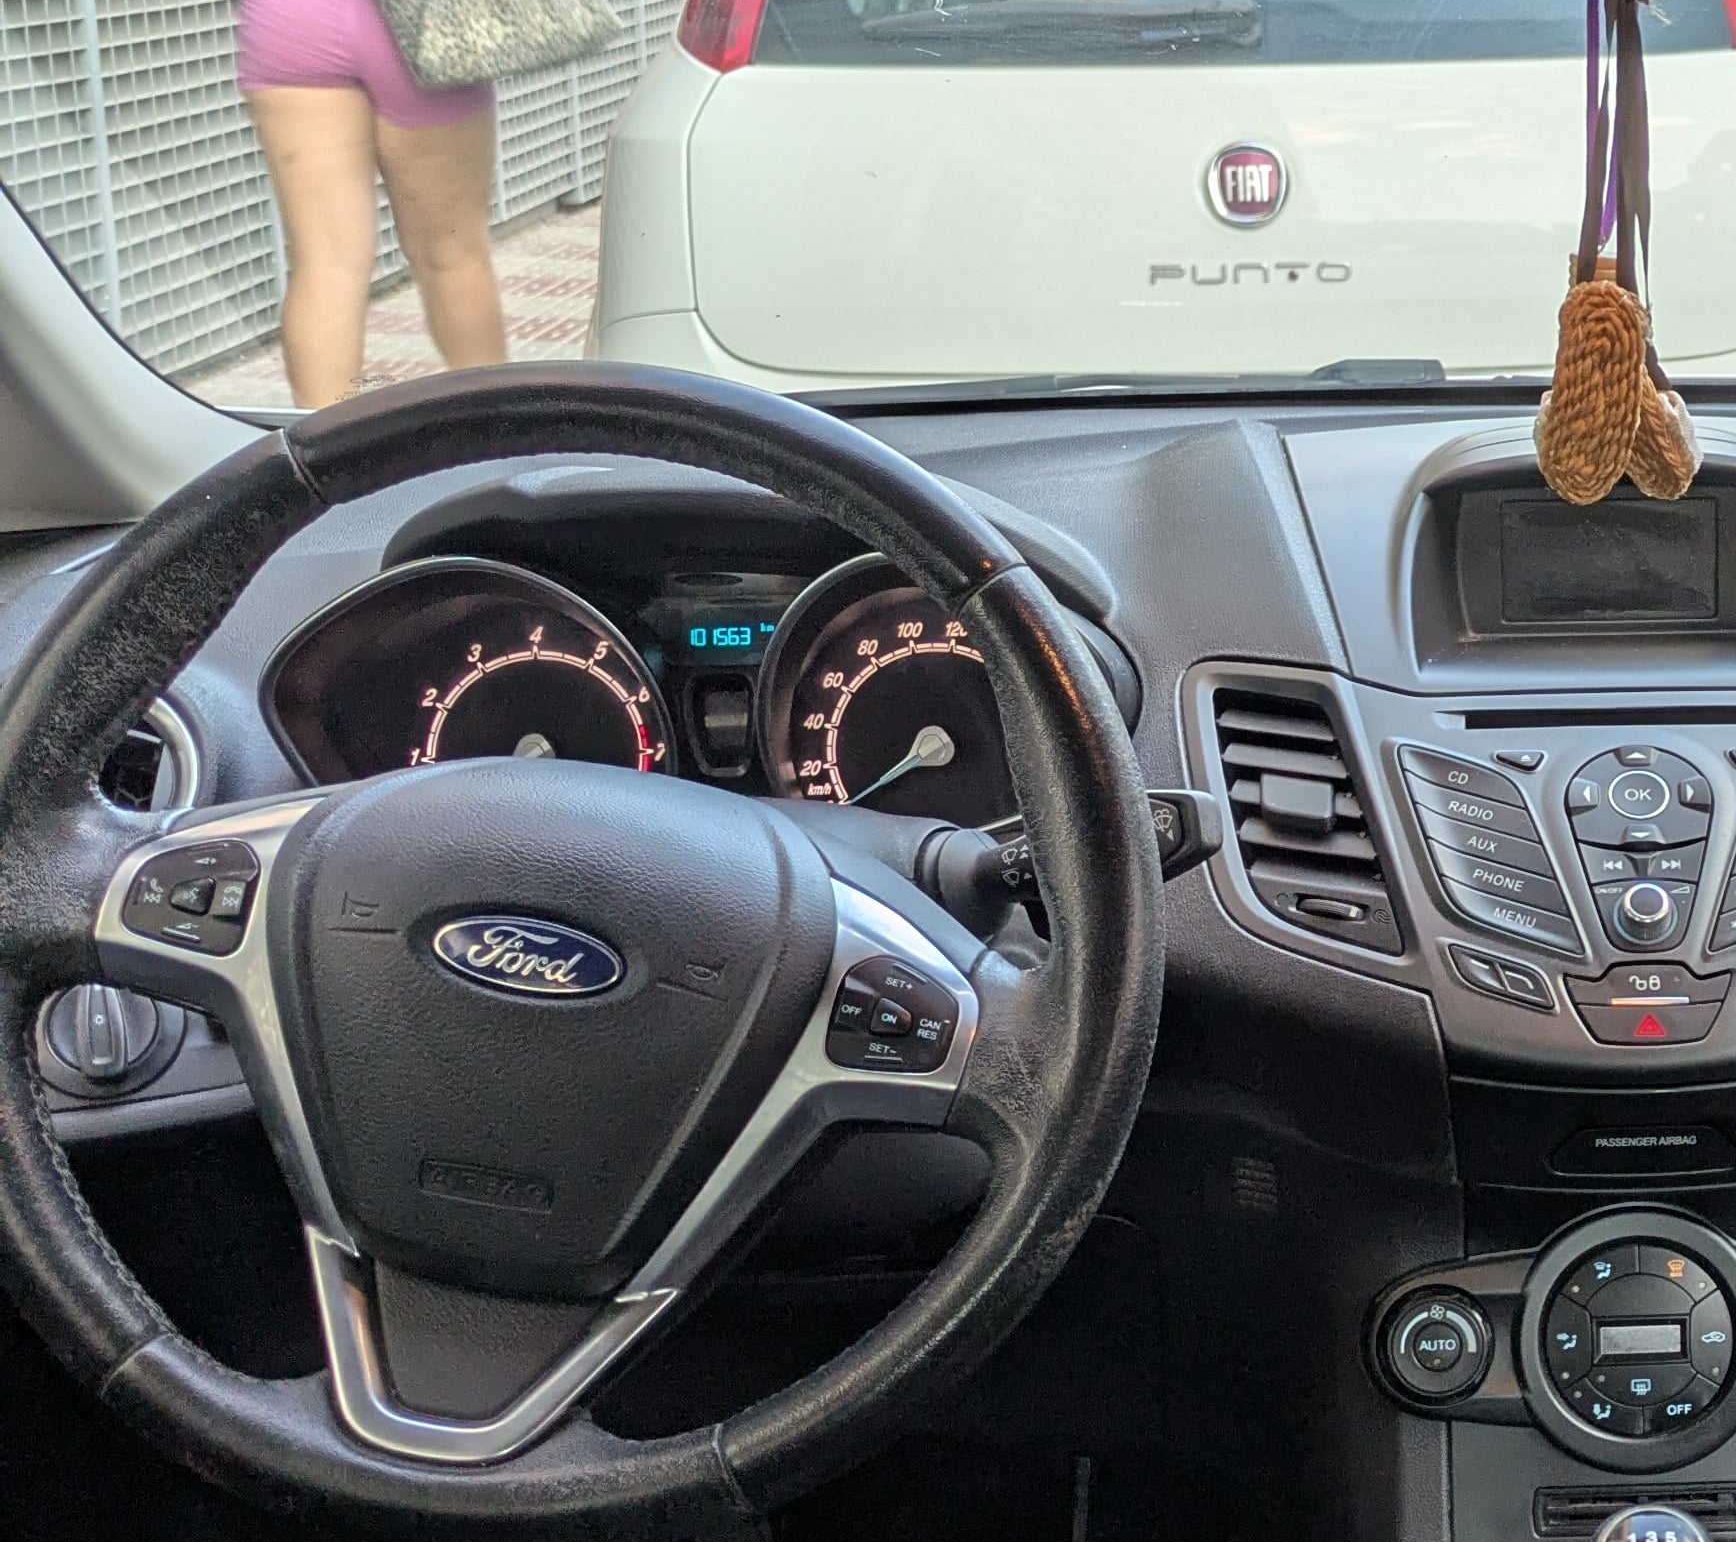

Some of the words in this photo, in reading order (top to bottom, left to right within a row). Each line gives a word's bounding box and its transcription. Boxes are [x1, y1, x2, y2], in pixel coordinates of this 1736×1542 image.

[1224, 163, 1273, 203] FIAT
[1150, 261, 1353, 286] PUNTO
[529, 626, 544, 644] 4
[897, 622, 923, 638] 100
[467, 643, 482, 663] 3
[593, 641, 609, 660] 5
[857, 639, 879, 656] 80
[822, 671, 844, 689] 60
[421, 687, 438, 707] 2
[638, 686, 650, 703] 6
[803, 713, 825, 730] 40
[410, 747, 421, 766] 1
[654, 743, 666, 762] 7
[799, 760, 822, 777] 20
[1447, 770, 1469, 785] CD
[807, 781, 832, 796] km/h
[1624, 788, 1652, 801] OK
[1448, 800, 1494, 821] RADIO
[1467, 836, 1498, 854] AUX
[1472, 868, 1525, 893] PHONE
[1493, 907, 1537, 928] MENU
[466, 925, 584, 983] Ford
[885, 977, 914, 990] SET+
[841, 1004, 862, 1016] OFF
[881, 1012, 897, 1024] ON
[919, 1018, 942, 1031] CAN
[917, 1028, 938, 1040] RES
[1595, 1136, 1658, 1147] PASSENGER
[1658, 1135, 1697, 1146] AIRBAG
[1419, 1338, 1457, 1353] AUTO
[1666, 1403, 1693, 1416] OFF
